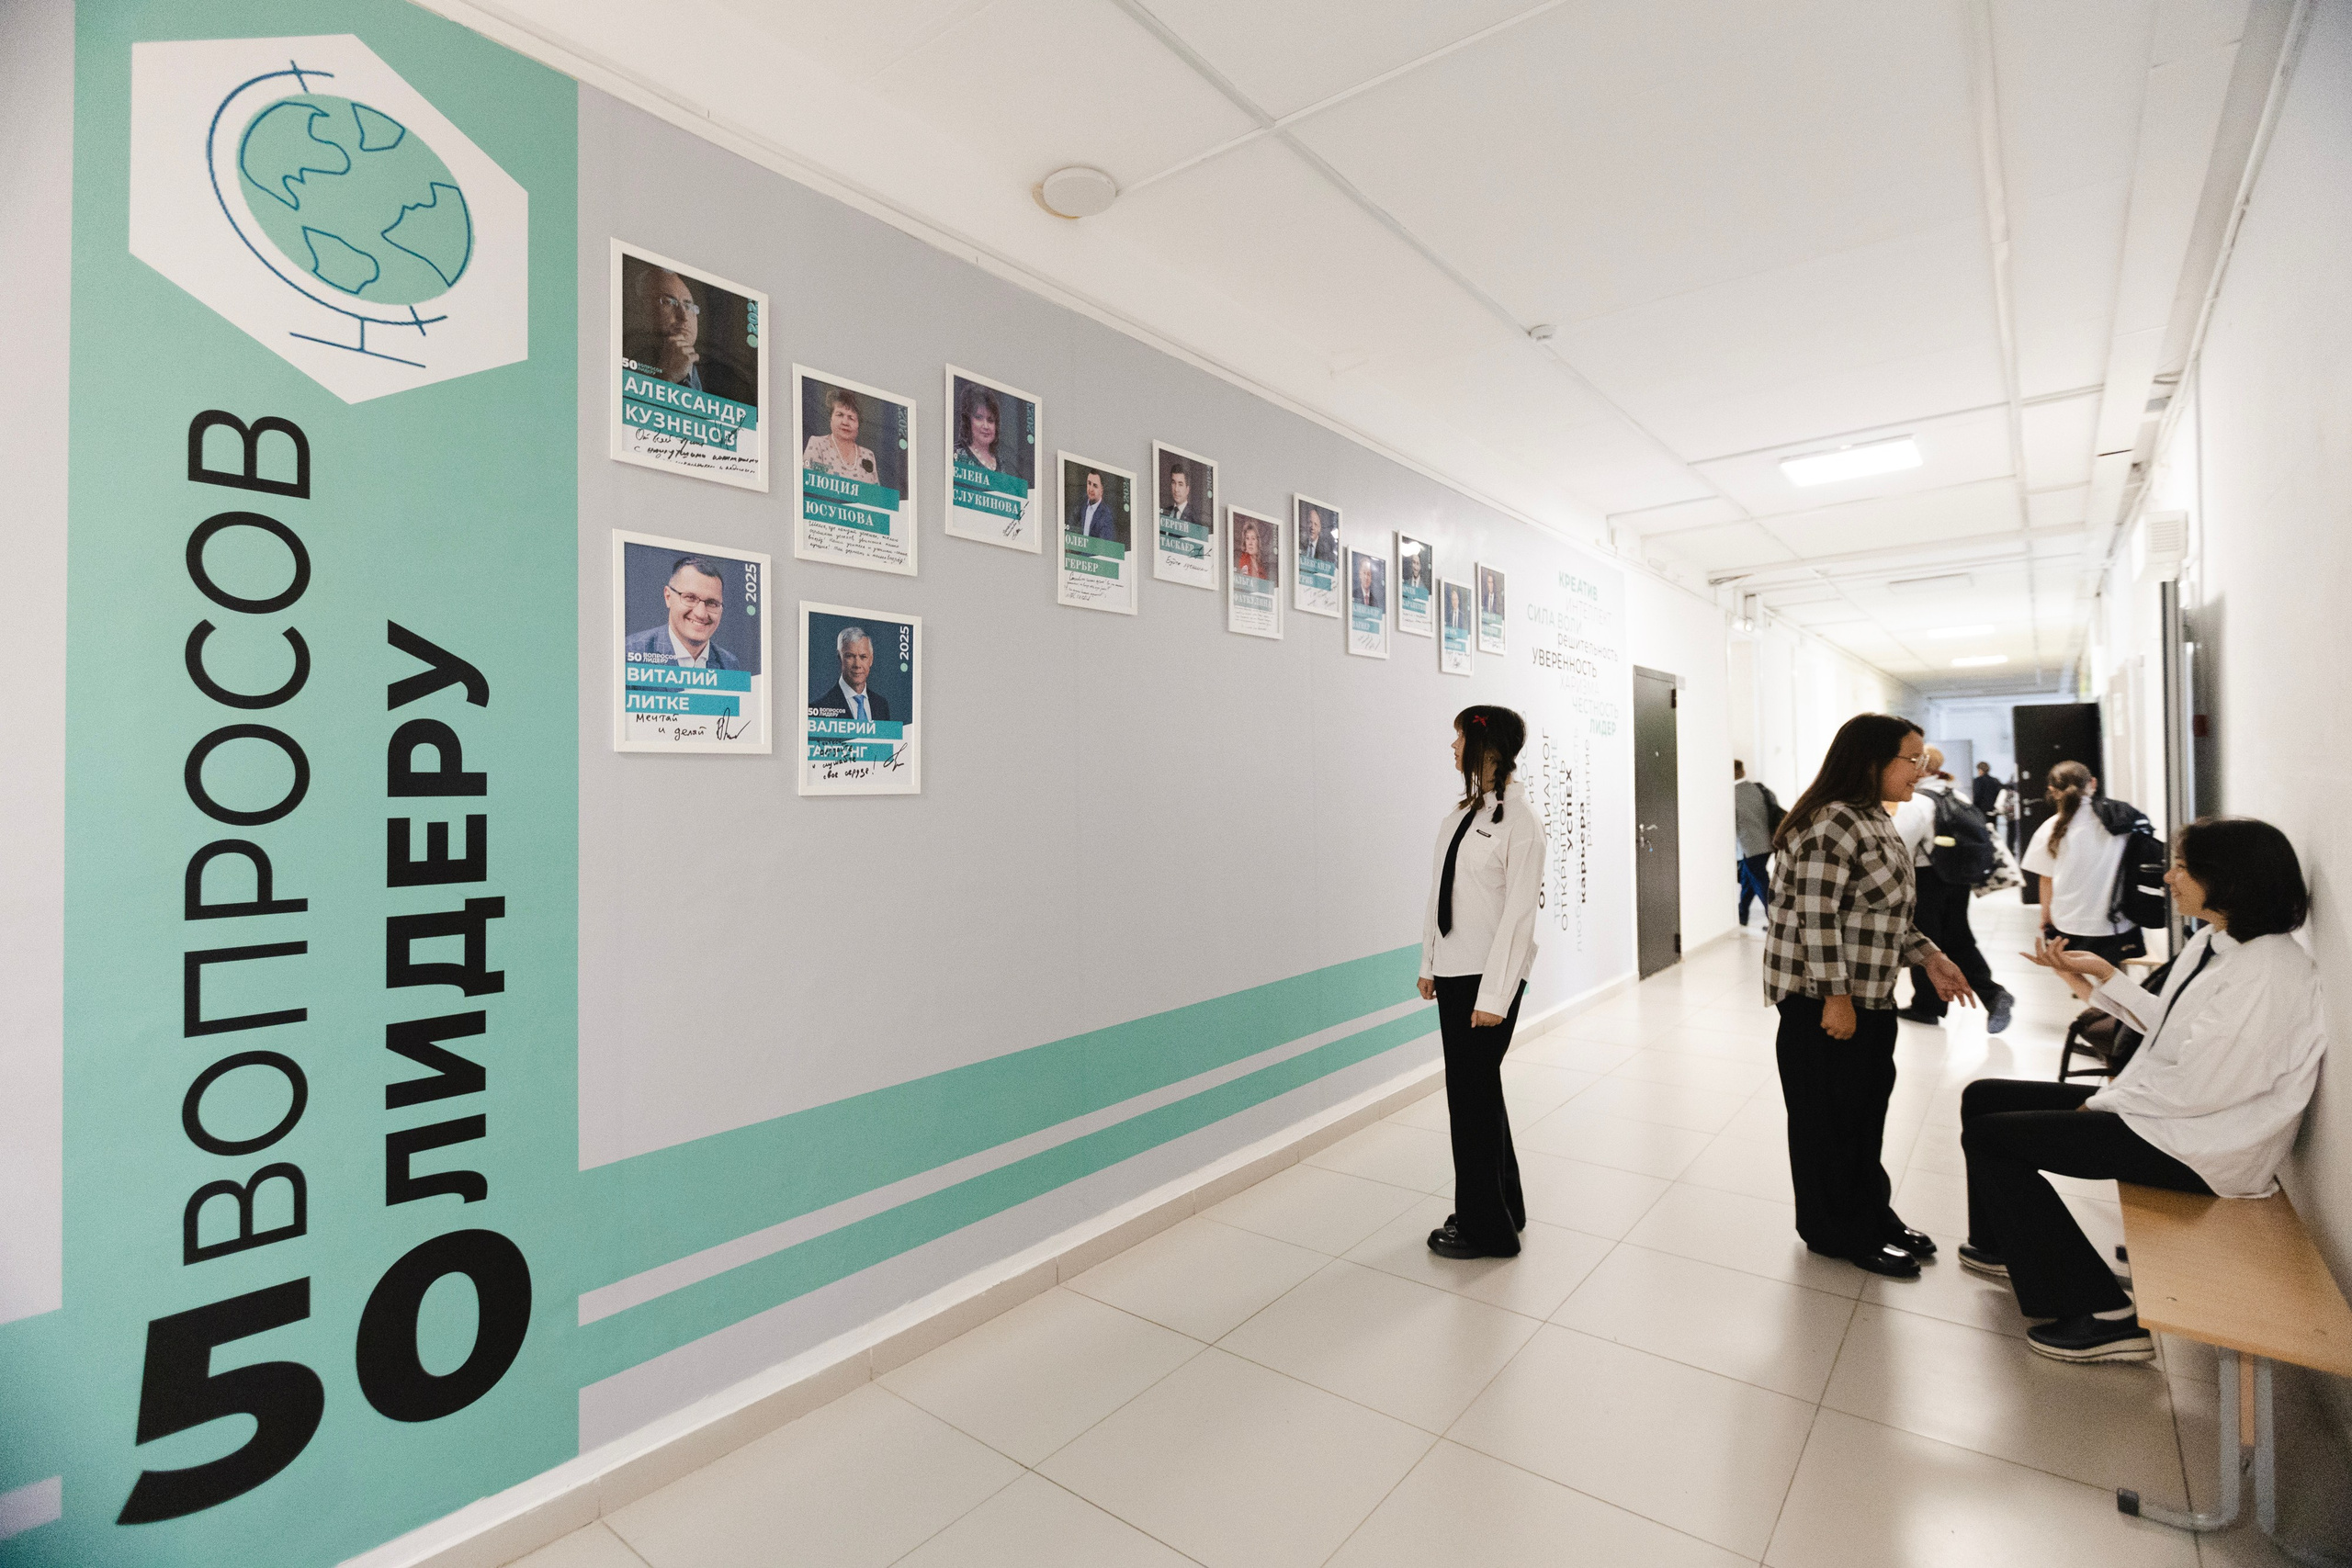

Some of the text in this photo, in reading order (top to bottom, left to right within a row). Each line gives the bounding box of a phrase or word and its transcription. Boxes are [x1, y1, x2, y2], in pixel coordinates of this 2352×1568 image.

[746, 299, 759, 336] 202
[622, 356, 638, 370] 50
[624, 376, 747, 424] АЛЕКСАНДР
[625, 403, 735, 446] КУЗНЕЦОВ
[805, 473, 860, 497] ЛЮЦИЯ
[954, 466, 989, 486] ЕЛЕНА
[805, 500, 874, 526] ЮСУПОВА
[953, 489, 1019, 514] СЛУКИНОВА
[1159, 516, 1189, 534] СЕРГЕЙ
[1065, 533, 1089, 547] ОЛЕГ
[1065, 557, 1099, 572] ГЕРБЕР
[745, 563, 756, 603] 2025
[1558, 570, 1599, 602] КРЕАТИВ
[1527, 603, 1582, 636] СИЛА ВОЛИ
[899, 626, 910, 660] 2025
[1557, 633, 1619, 662] решительность
[628, 652, 642, 662] 50
[1532, 646, 1598, 679] УВЕРЕННОСТЬ
[627, 667, 718, 686] ВИТАЛИЙ
[626, 694, 689, 711] ЛИТКЕ
[808, 707, 819, 716] 50
[1572, 696, 1619, 719] ЧЕСТНОСТЬ
[808, 719, 876, 735] ВАЛЕРИЙ
[1589, 718, 1617, 737] ЛИДЕР
[1543, 728, 1552, 839] ДИАЛОГ
[183, 408, 312, 1268] ВОПРОСОВ
[1551, 739, 1560, 923] ТРУДОЛЮБИЕ
[1559, 761, 1567, 931] ОТКРЫТОСТЬ
[386, 618, 506, 1207] ЛИДЕРУ
[115, 1227, 533, 1527] 50
